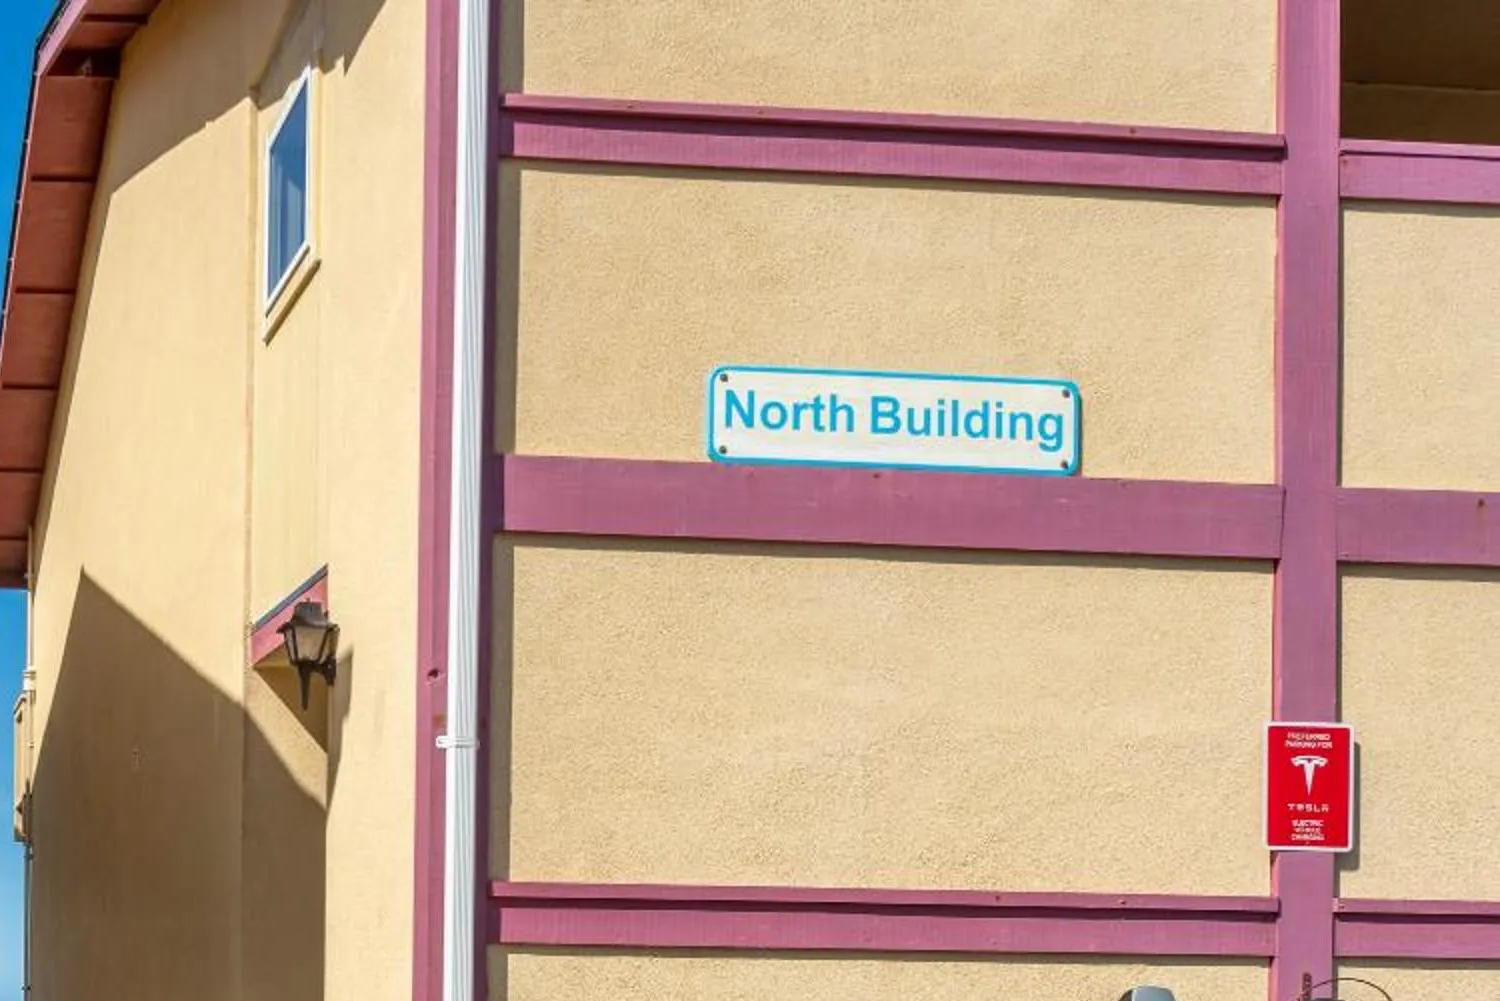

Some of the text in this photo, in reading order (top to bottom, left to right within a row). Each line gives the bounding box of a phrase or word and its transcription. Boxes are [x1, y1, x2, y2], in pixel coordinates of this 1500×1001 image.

[724, 389, 1064, 453] North Building
[1287, 802, 1329, 813] TESLA
